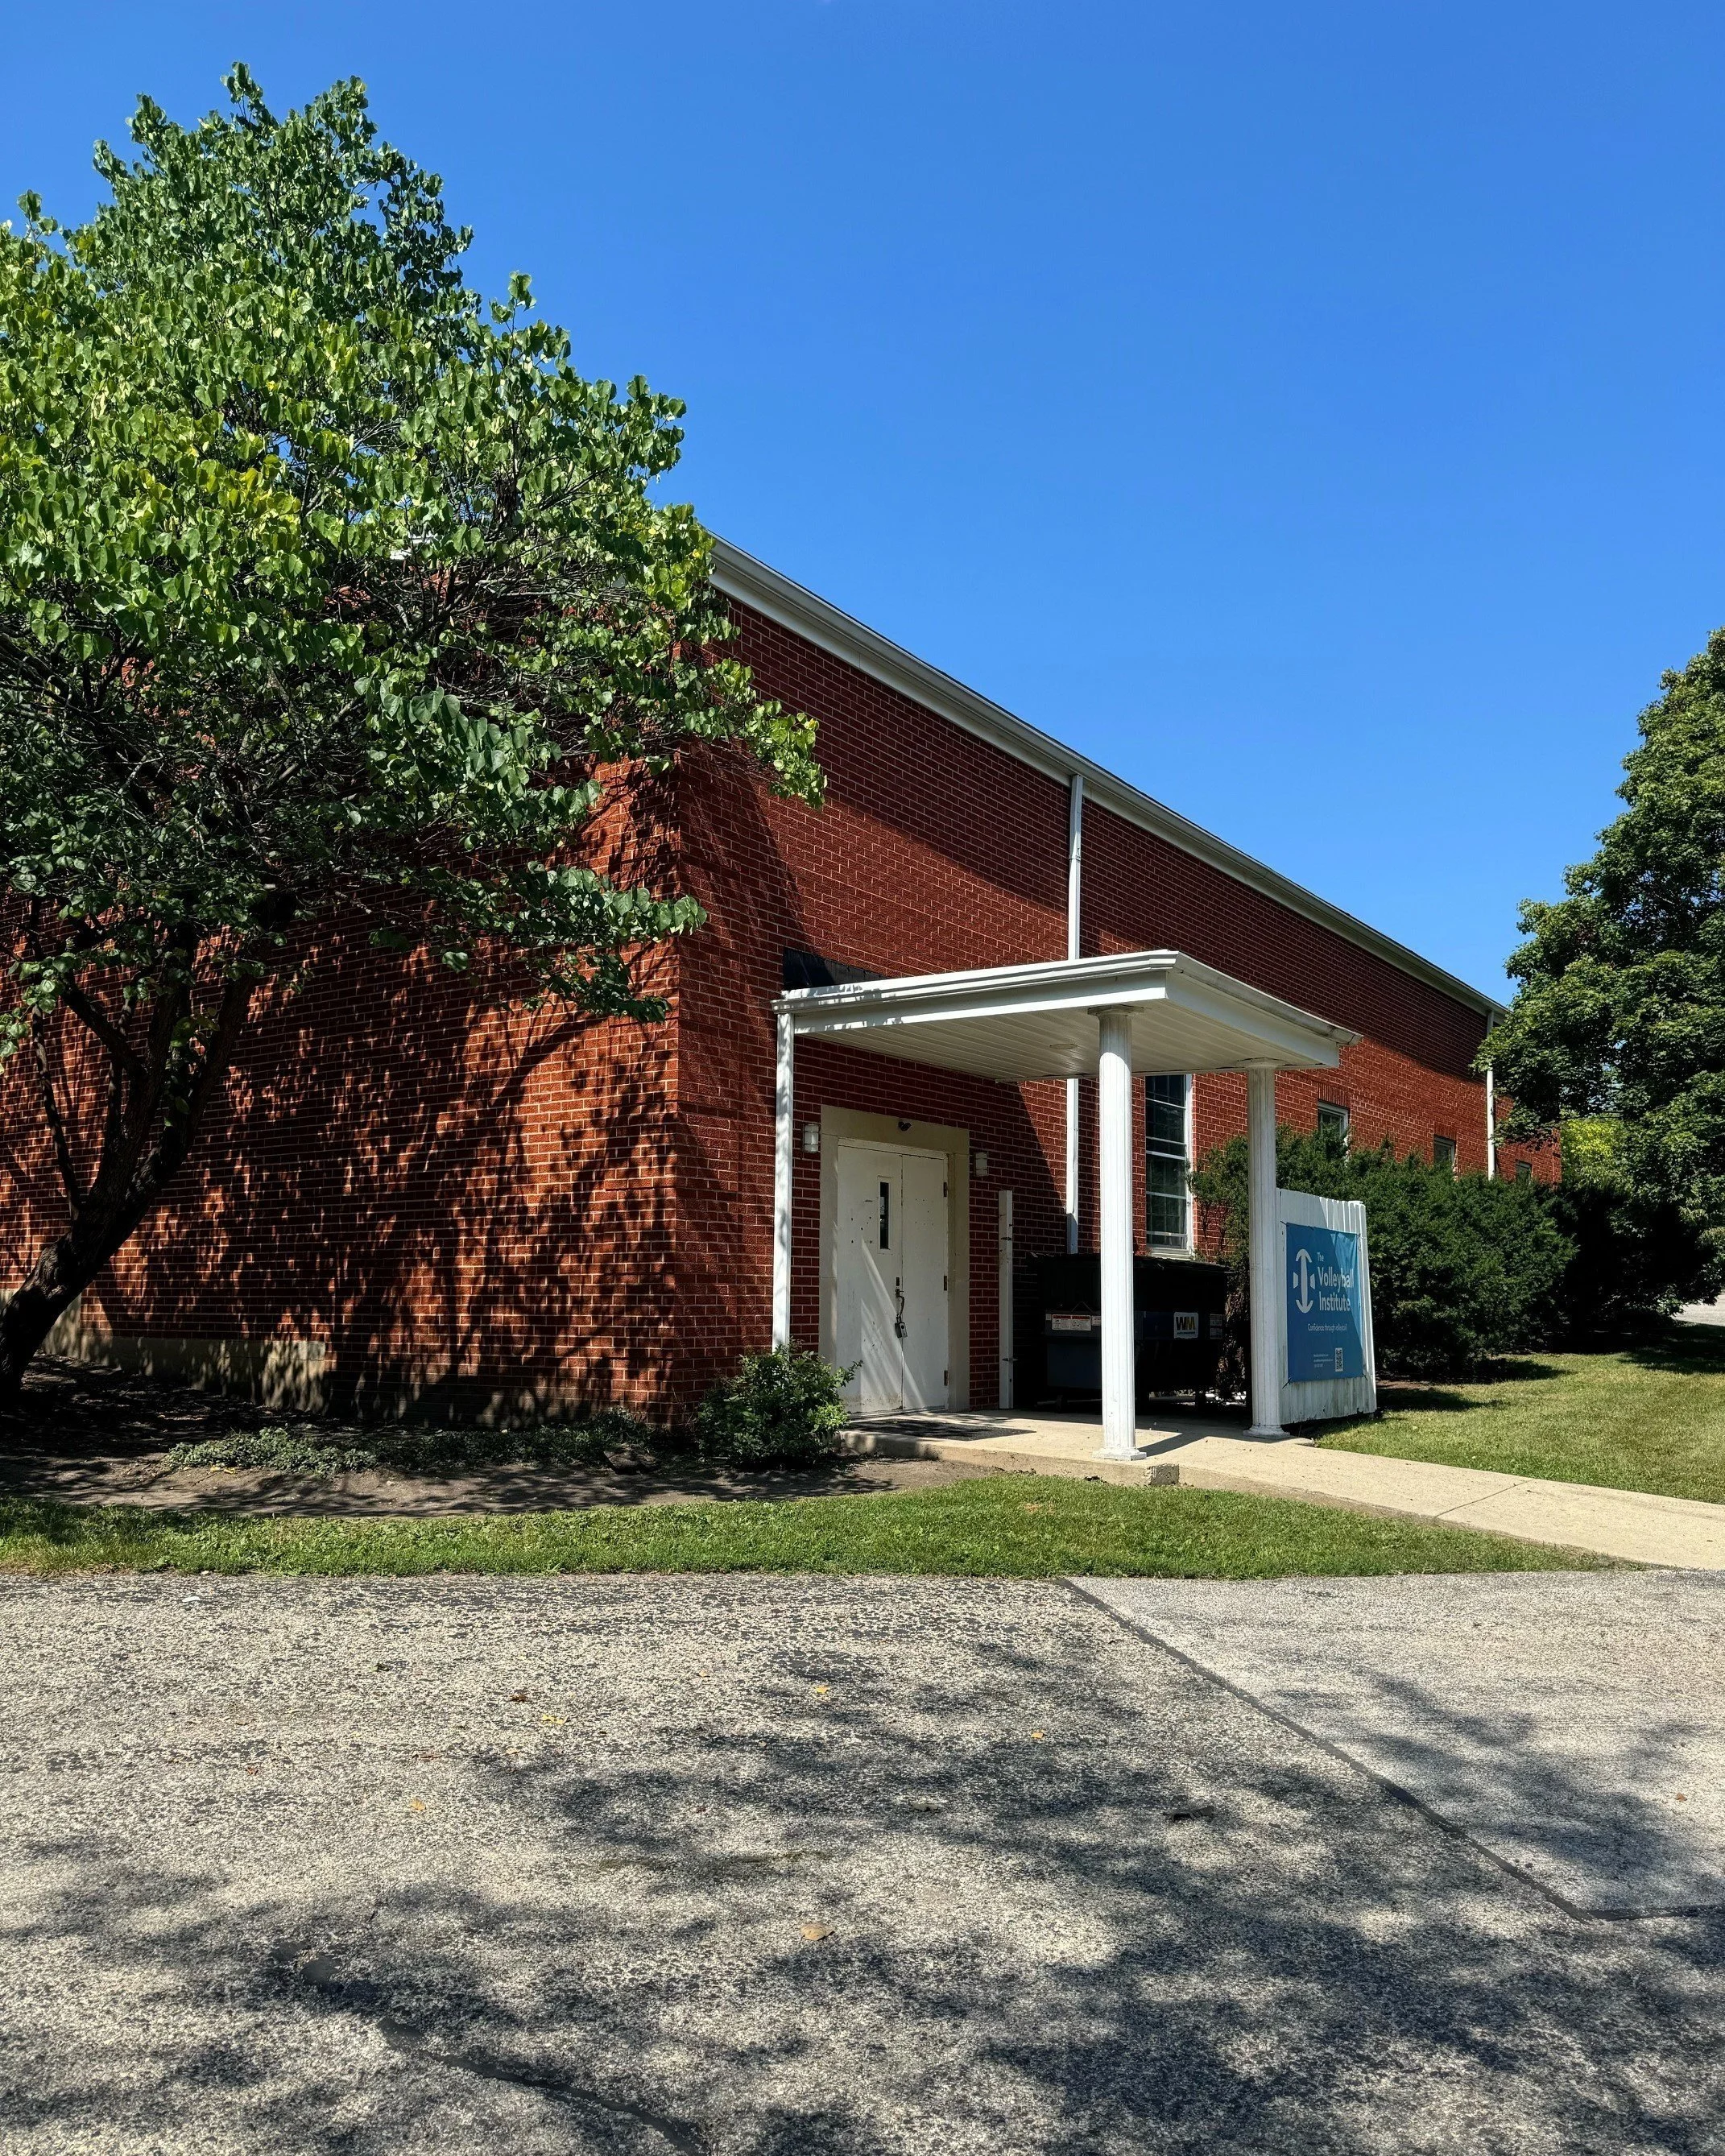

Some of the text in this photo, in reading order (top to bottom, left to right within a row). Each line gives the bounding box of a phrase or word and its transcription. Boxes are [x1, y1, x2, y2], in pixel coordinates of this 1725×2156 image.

[1317, 1252, 1325, 1262] The
[1318, 1266, 1355, 1293] Volleyball
[1319, 1291, 1351, 1311] Institute
[1176, 1317, 1196, 1330] WM
